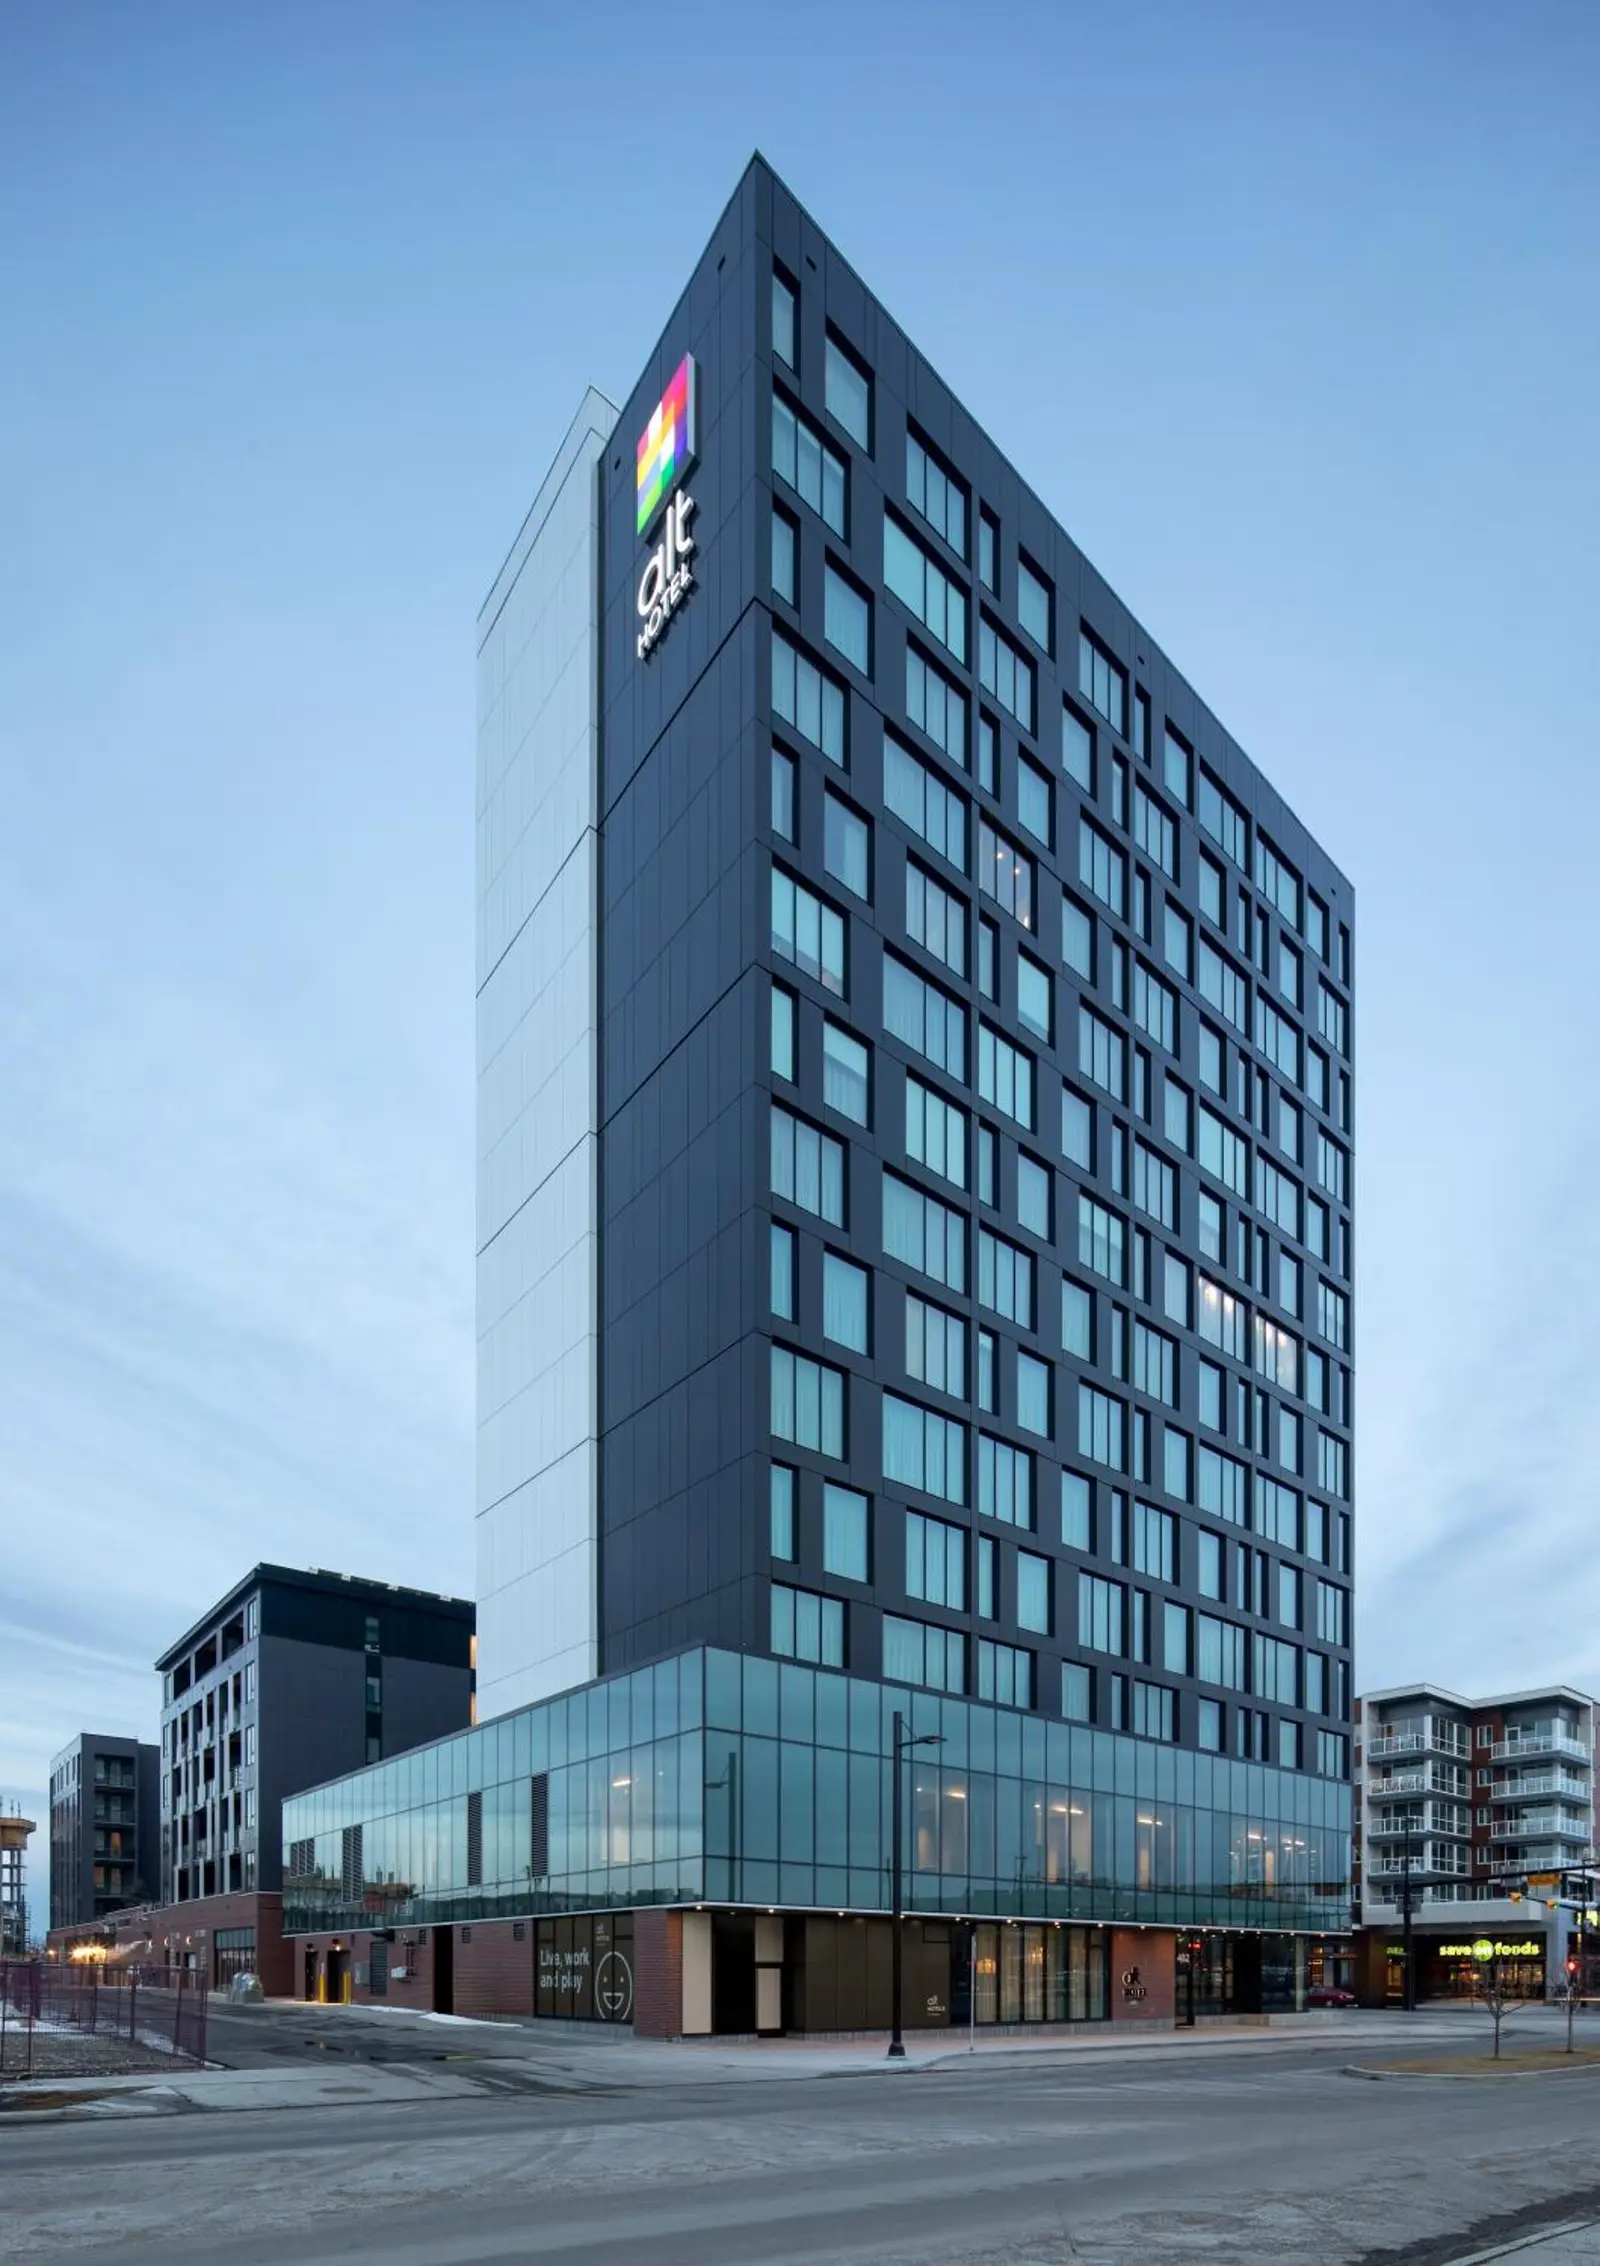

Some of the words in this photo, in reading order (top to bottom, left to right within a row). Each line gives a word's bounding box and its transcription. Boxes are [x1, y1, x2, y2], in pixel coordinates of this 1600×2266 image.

[637, 488, 694, 616] alt
[637, 563, 694, 660] HOTEL
[540, 1949, 563, 1968] Live,
[564, 1946, 590, 1966] work
[1439, 1944, 1473, 1956] save
[1494, 1941, 1540, 1956] foods
[540, 1970, 559, 1989] and
[561, 1970, 584, 1993] play
